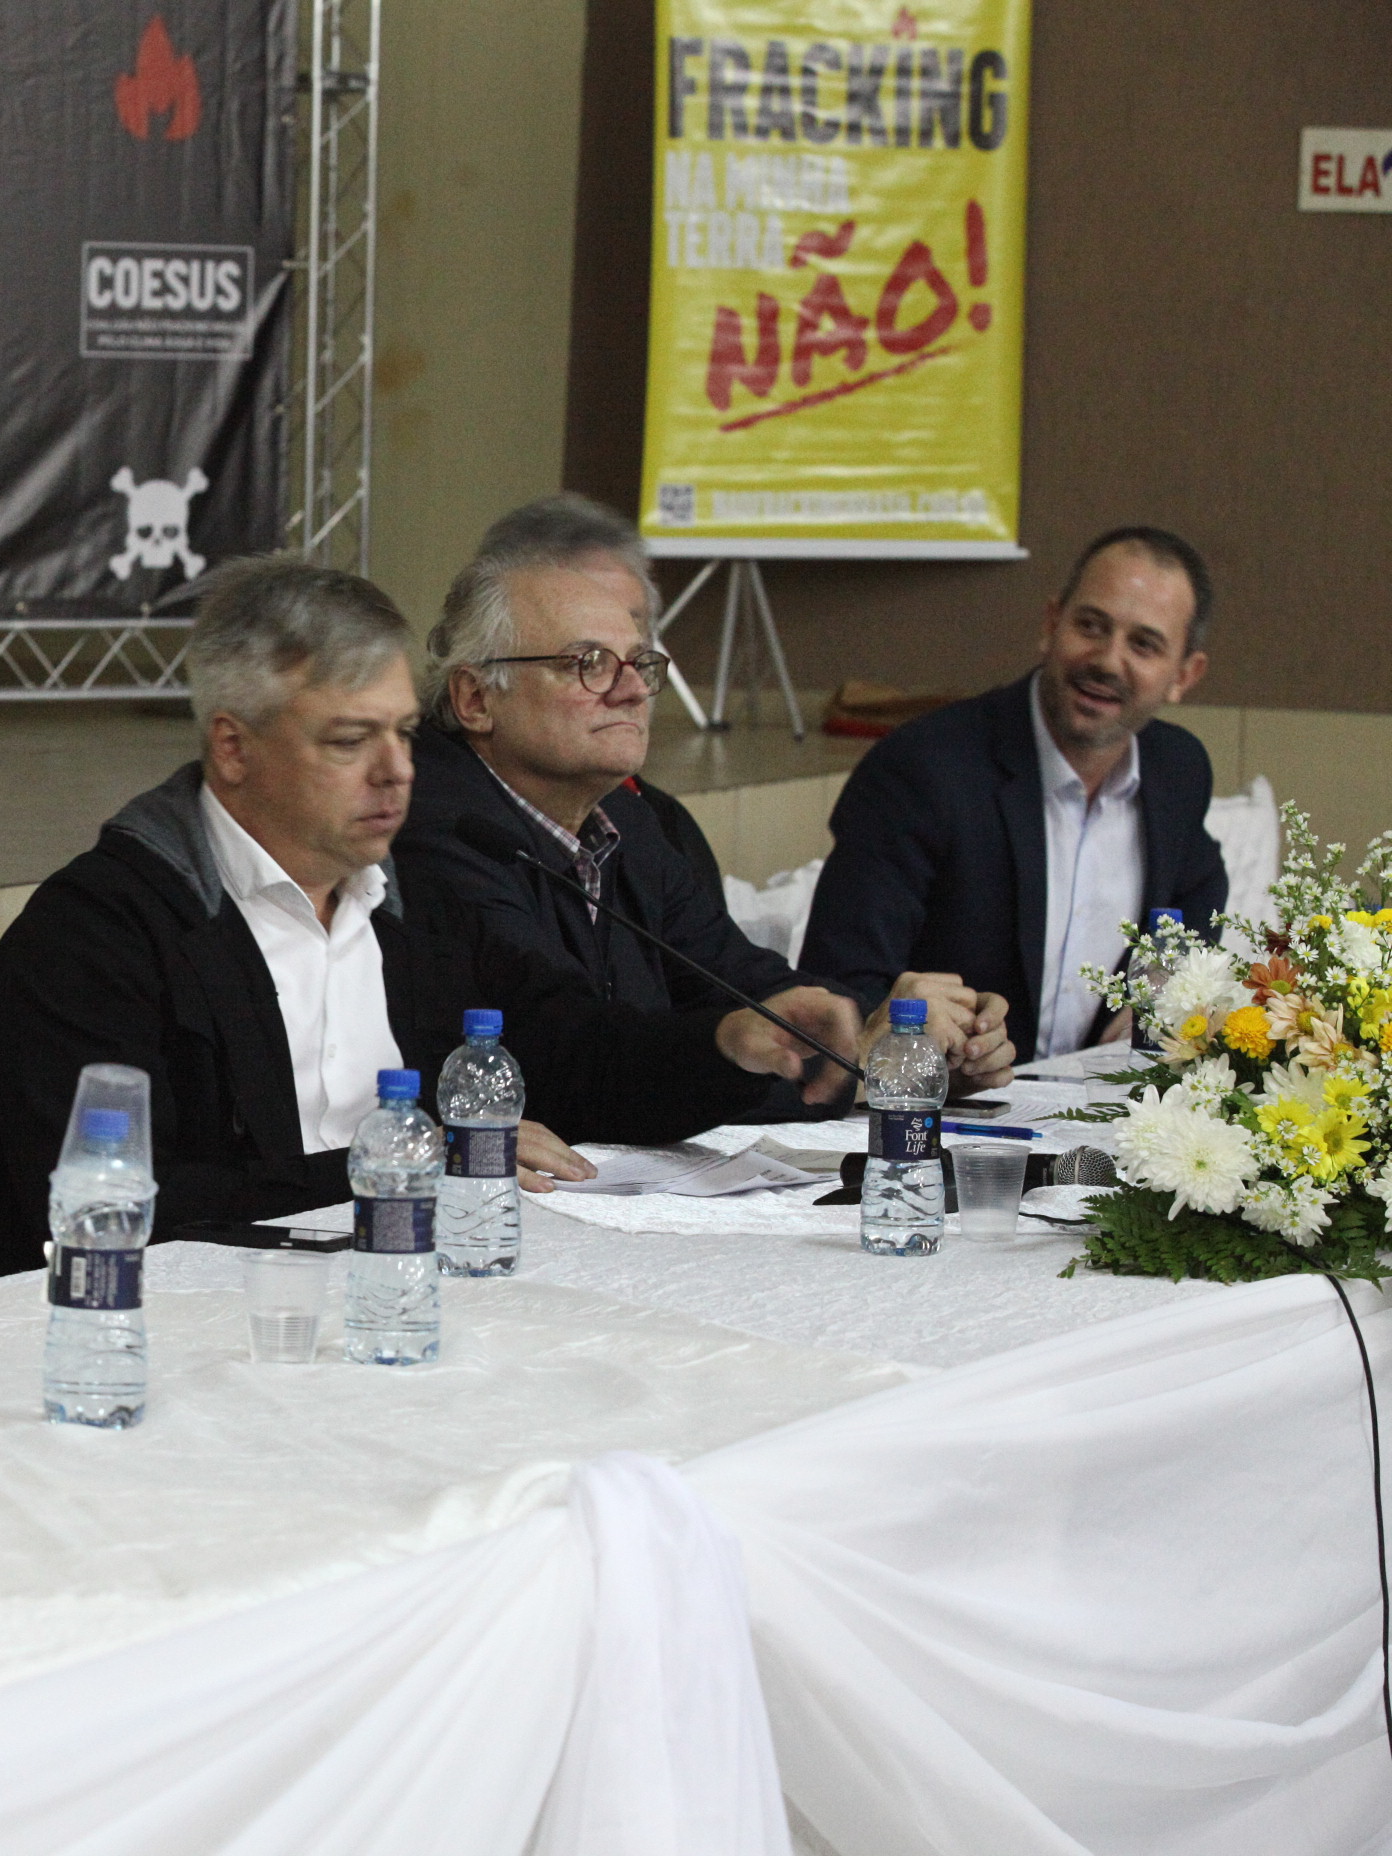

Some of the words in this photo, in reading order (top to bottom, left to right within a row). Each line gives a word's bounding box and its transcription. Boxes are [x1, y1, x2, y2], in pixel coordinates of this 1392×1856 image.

[667, 36, 1007, 151] FRACKING
[665, 151, 716, 209] NA
[664, 211, 786, 269] TERRA
[88, 256, 243, 313] COESUS
[706, 199, 993, 412] NÃO!
[905, 1129, 927, 1141] Font
[905, 1141, 926, 1155] Life
